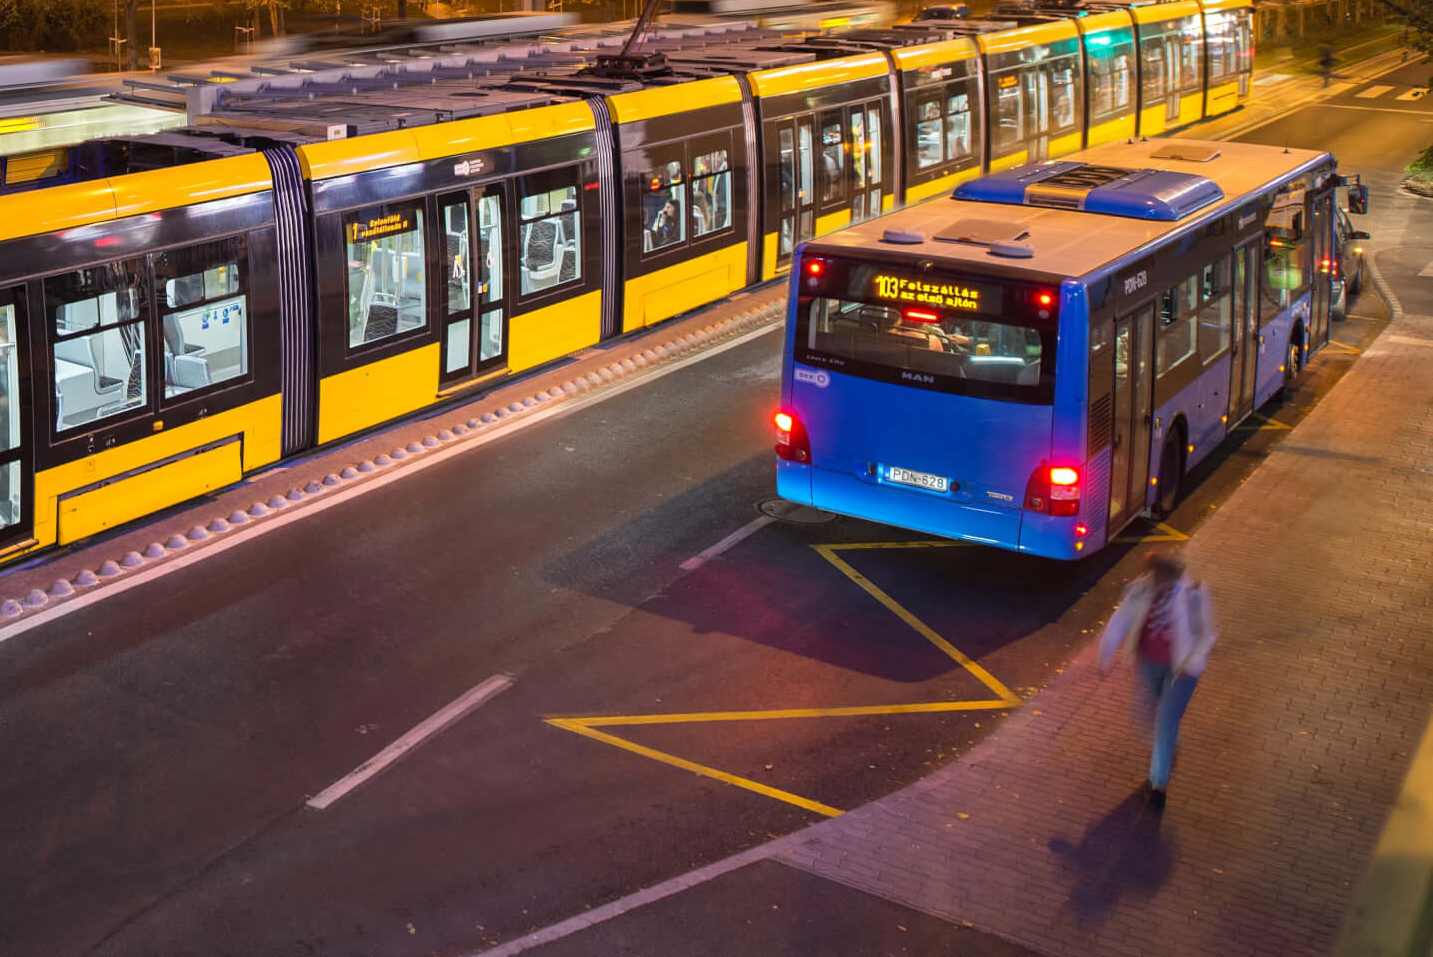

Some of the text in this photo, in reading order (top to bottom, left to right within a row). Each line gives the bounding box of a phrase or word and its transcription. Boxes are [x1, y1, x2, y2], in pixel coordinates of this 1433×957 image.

[875, 275, 978, 299] 103 Felszállás
[900, 291, 915, 300] az
[946, 297, 977, 309] ajtón
[901, 371, 934, 383] MAN
